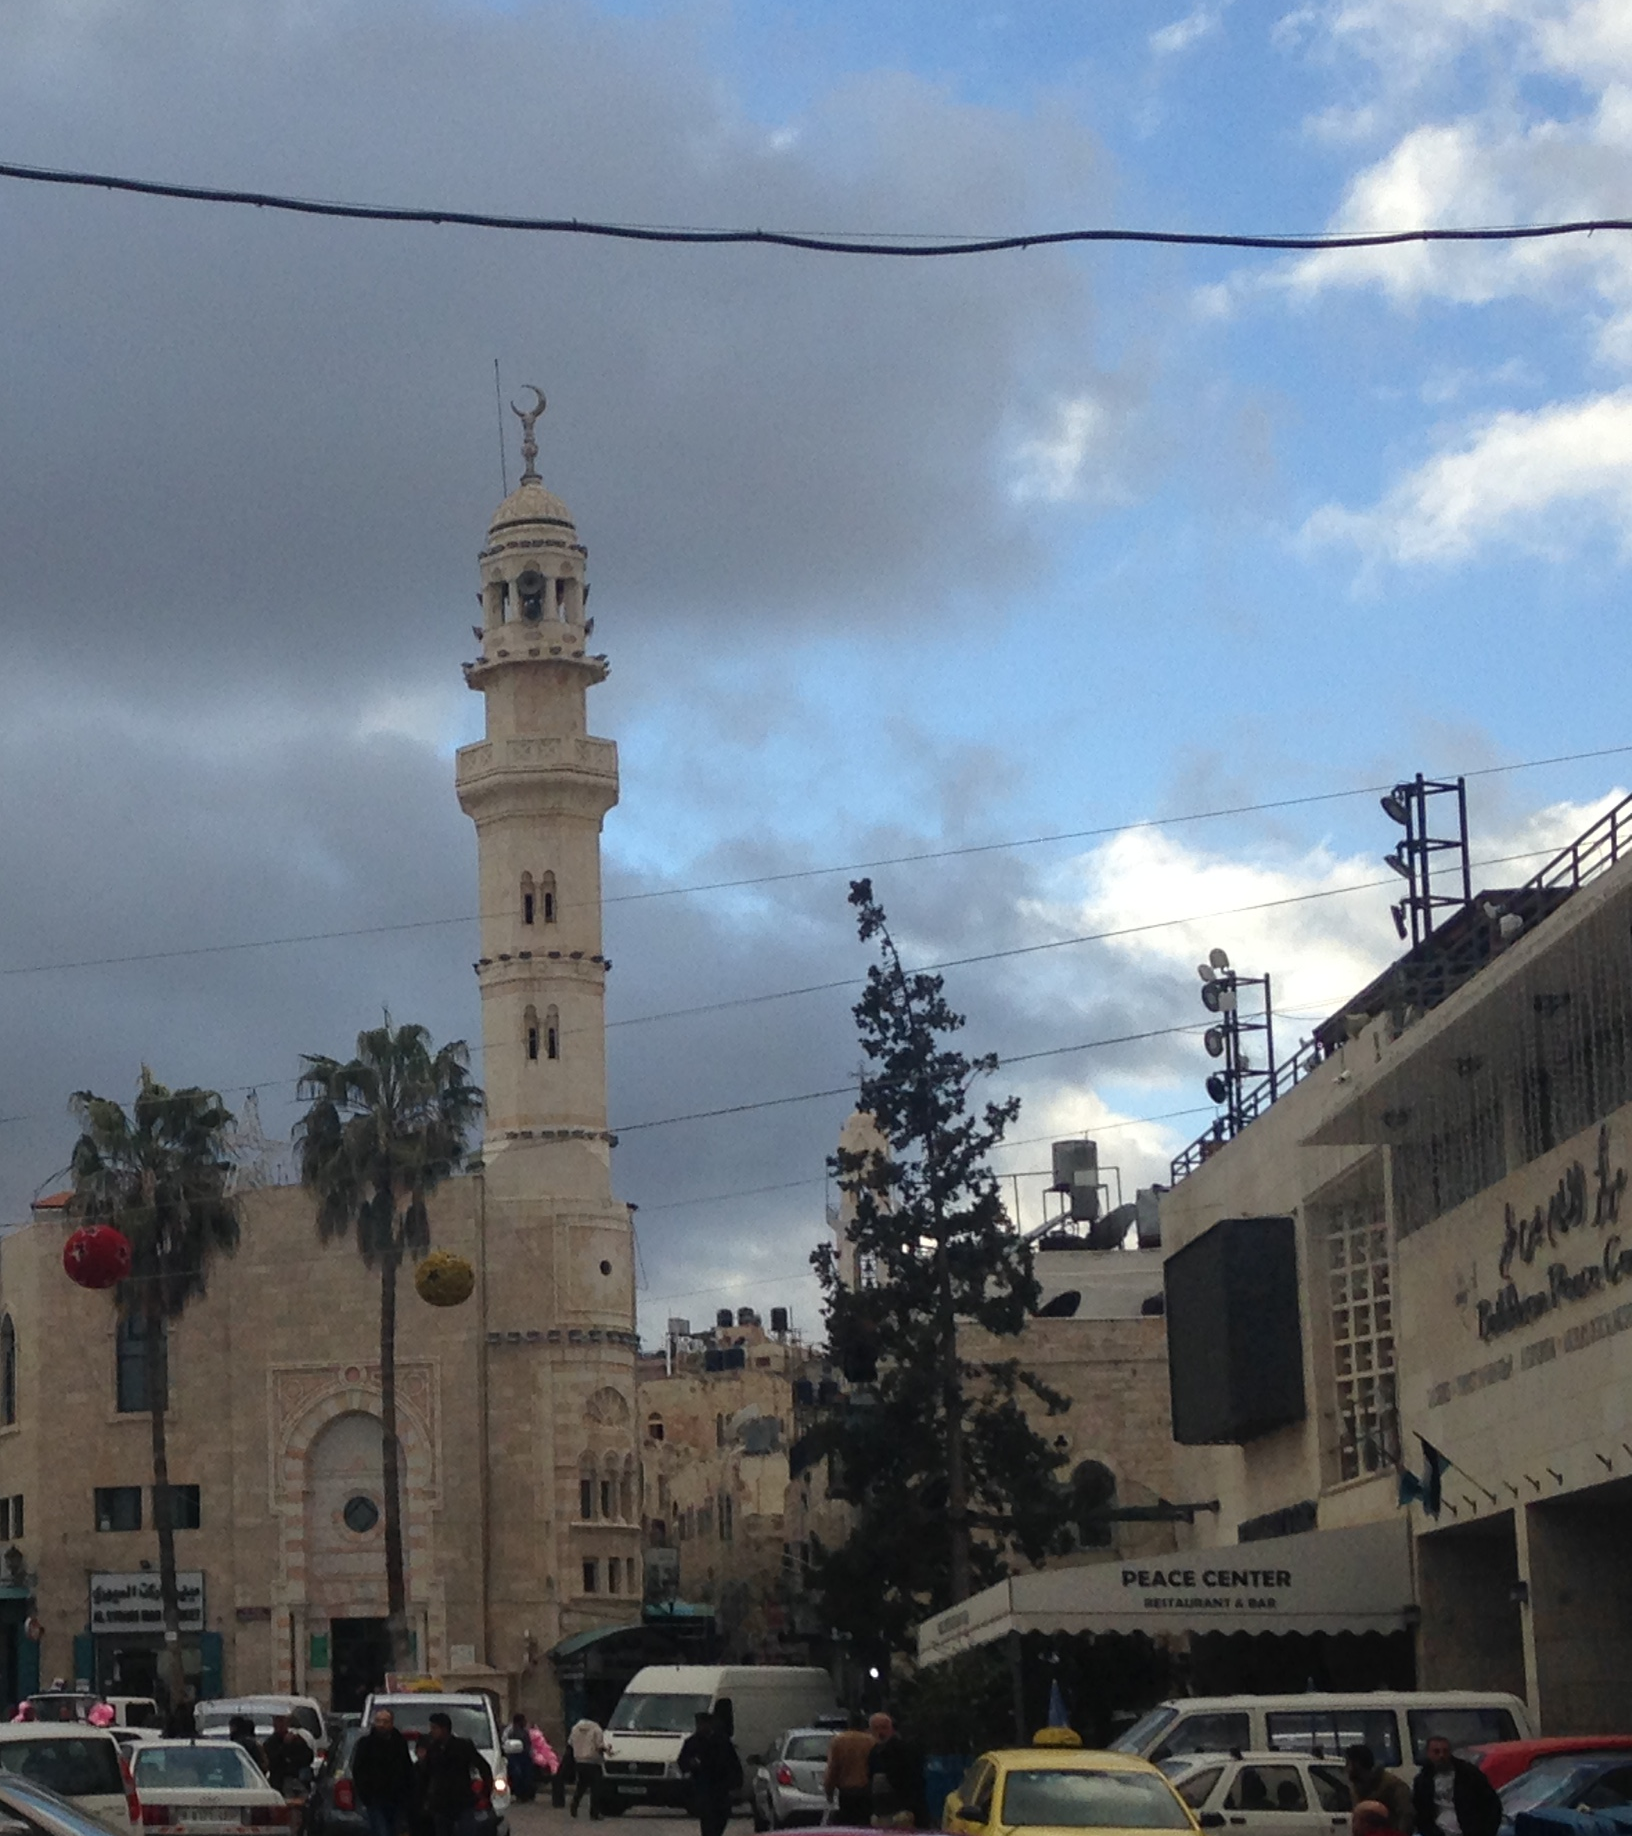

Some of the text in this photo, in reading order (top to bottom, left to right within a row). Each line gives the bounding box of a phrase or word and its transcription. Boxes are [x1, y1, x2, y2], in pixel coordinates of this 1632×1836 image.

[1121, 1569, 1292, 1588] PEACE CENTER
[1143, 1597, 1230, 1609] RESTAURANT
[1247, 1597, 1277, 1609] BAR
